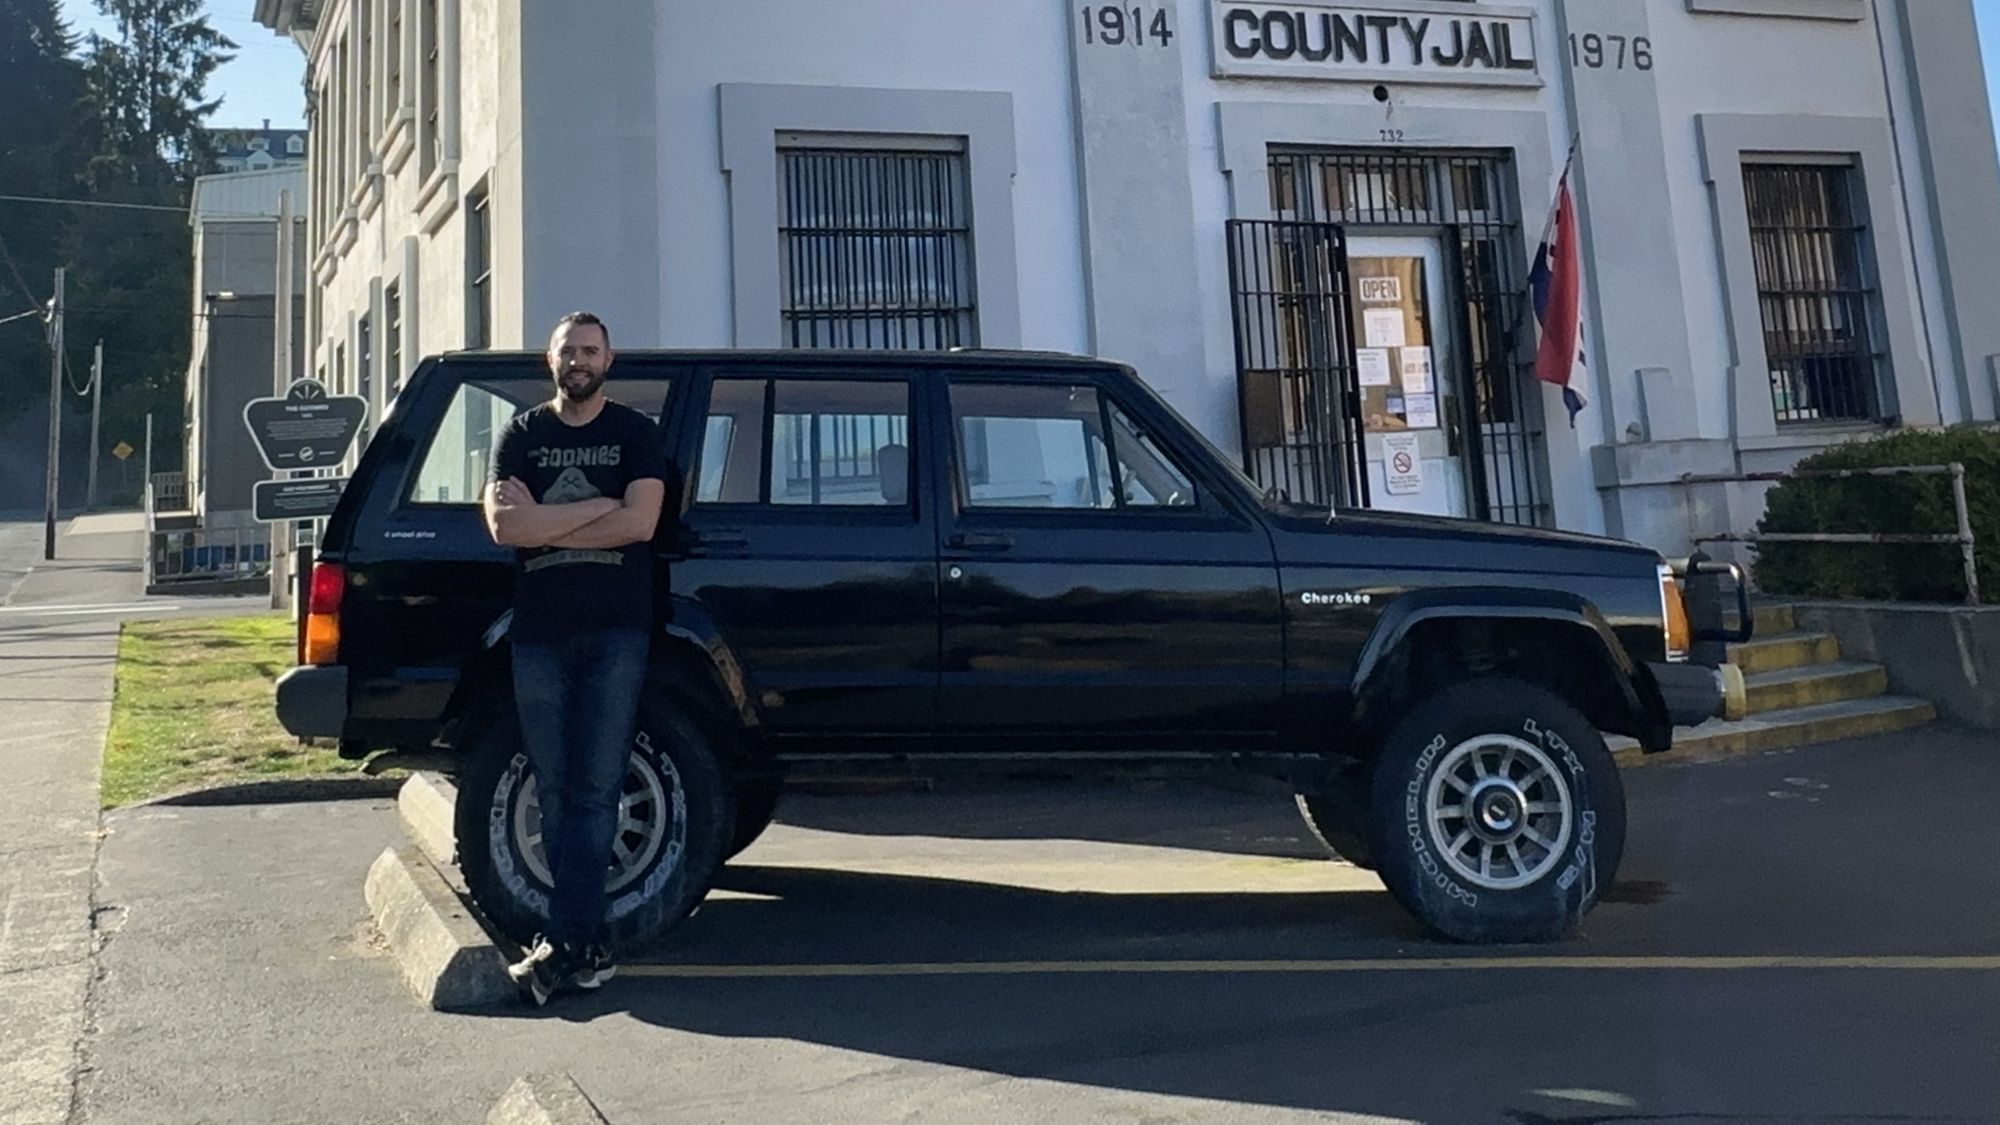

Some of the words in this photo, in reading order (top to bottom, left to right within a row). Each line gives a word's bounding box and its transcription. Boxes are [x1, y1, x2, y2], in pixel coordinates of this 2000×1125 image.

[1081, 5, 1174, 48] 1914
[1223, 8, 1430, 66] COUNTY
[1430, 20, 1534, 70] JAIL
[1567, 32, 1653, 71] 1976
[1379, 129, 1404, 143] 732
[1362, 279, 1398, 299] OPEN
[1301, 592, 1371, 604] Cherokee
[1523, 717, 1585, 776] LTX
